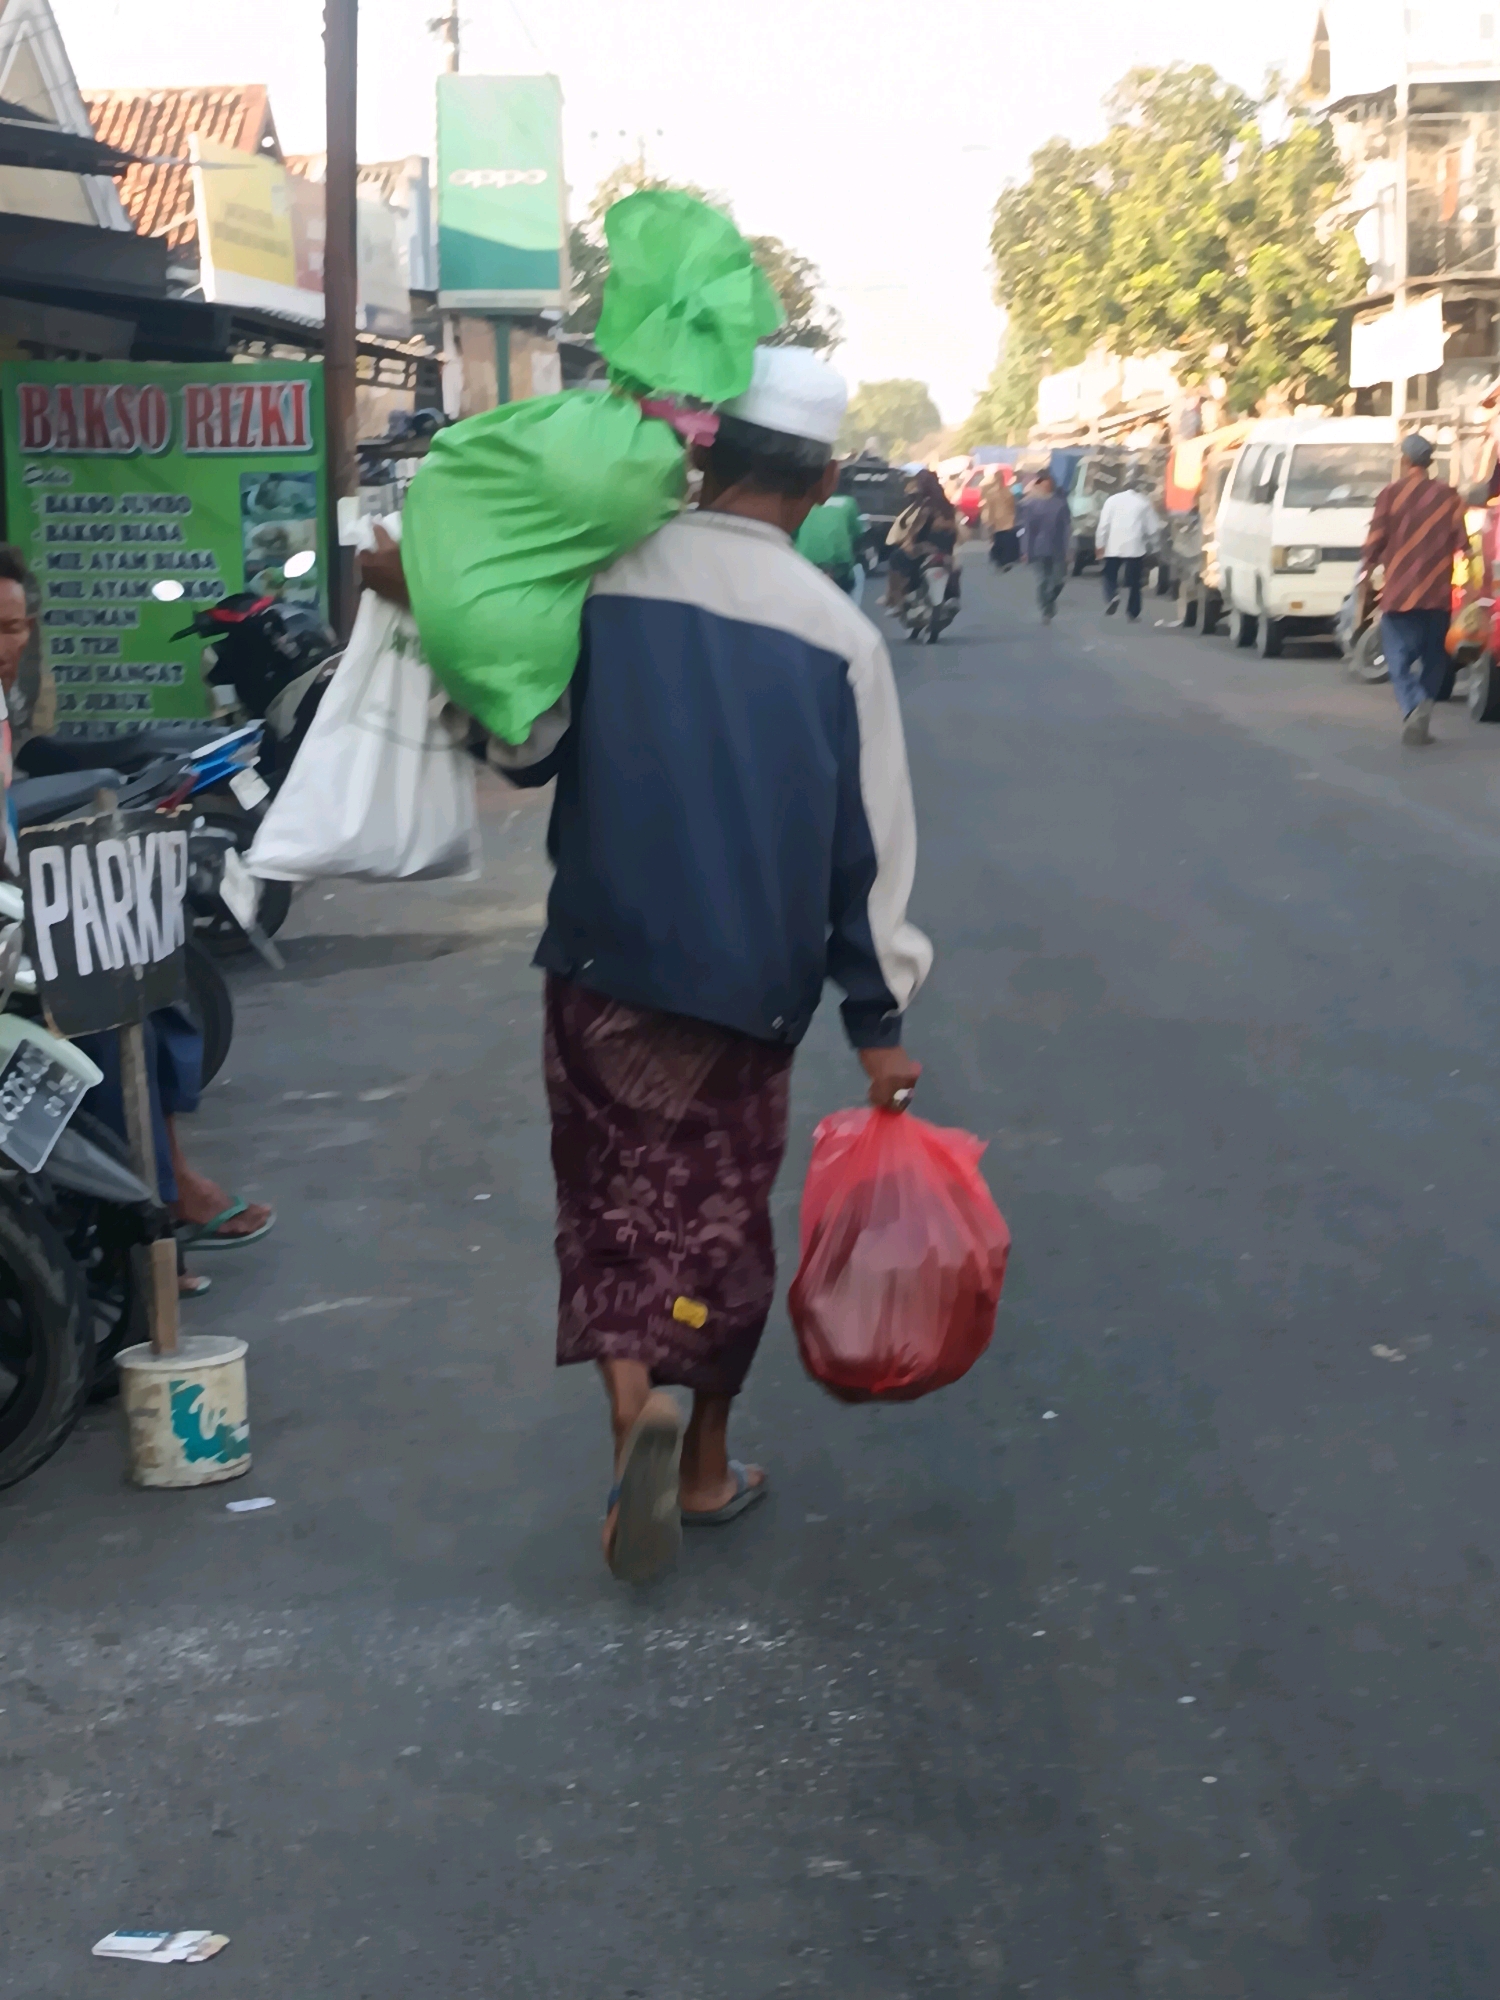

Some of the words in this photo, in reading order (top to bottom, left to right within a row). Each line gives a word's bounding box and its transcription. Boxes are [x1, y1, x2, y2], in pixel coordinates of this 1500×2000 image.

[449, 169, 547, 188] oppo
[18, 384, 168, 451] BAKSO
[183, 381, 311, 450] RIZKI
[89, 552, 148, 570] AYAM
[90, 580, 149, 599] AYAM
